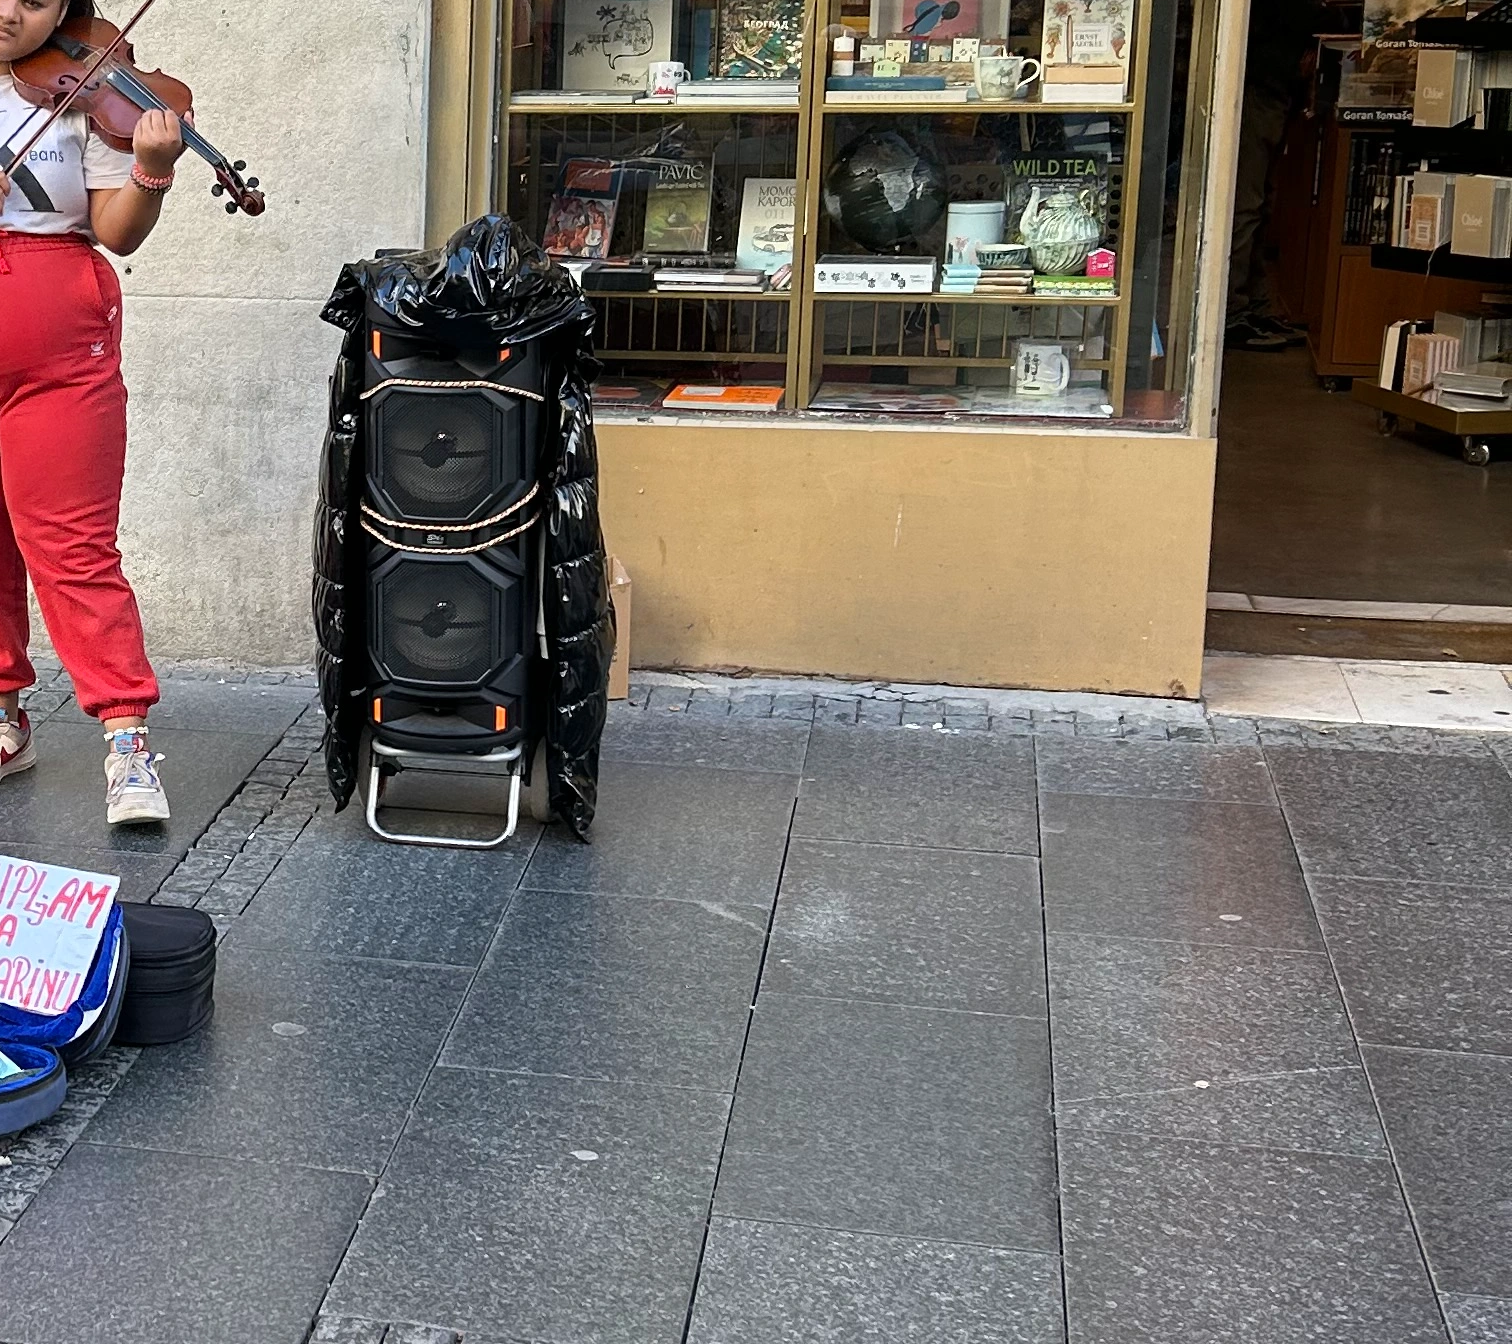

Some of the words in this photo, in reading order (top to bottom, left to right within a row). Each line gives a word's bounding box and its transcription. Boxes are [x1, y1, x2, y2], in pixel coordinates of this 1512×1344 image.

[1375, 39, 1406, 48] Goran
[1343, 110, 1374, 121] Goran
[23, 148, 65, 163] eans
[1012, 159, 1060, 176] WILD
[1063, 159, 1098, 176] TEA
[757, 196, 796, 207] KAPOR
